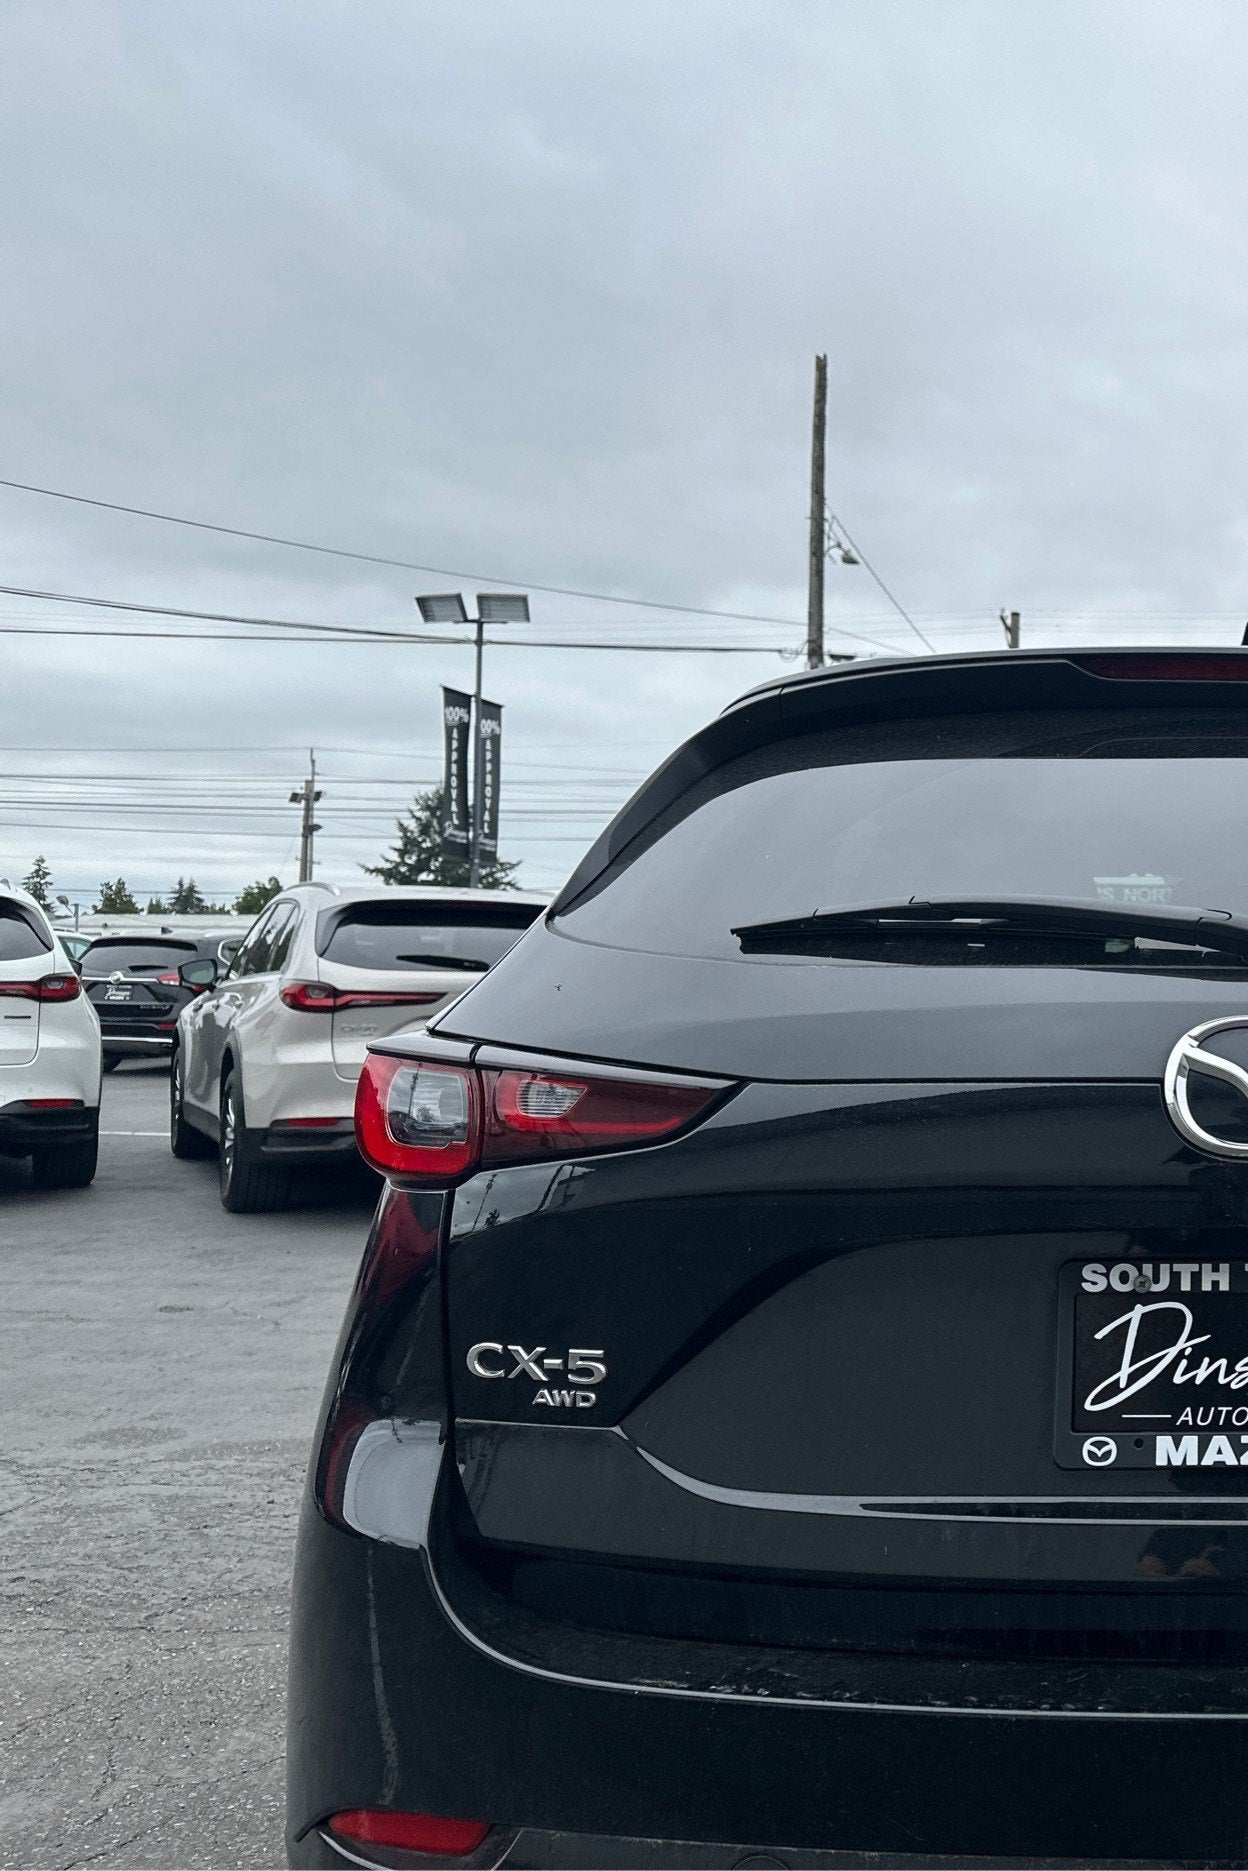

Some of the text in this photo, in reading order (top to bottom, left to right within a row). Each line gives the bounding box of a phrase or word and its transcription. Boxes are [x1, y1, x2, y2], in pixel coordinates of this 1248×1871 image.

[444, 706, 469, 723] 100%
[480, 718, 500, 735] 00%
[451, 727, 459, 825] APPROVAL
[484, 738, 492, 834] APPROVAL
[1081, 1263, 1230, 1293] SOUTH
[466, 1342, 608, 1385] CX-5
[532, 1389, 597, 1408] AWD
